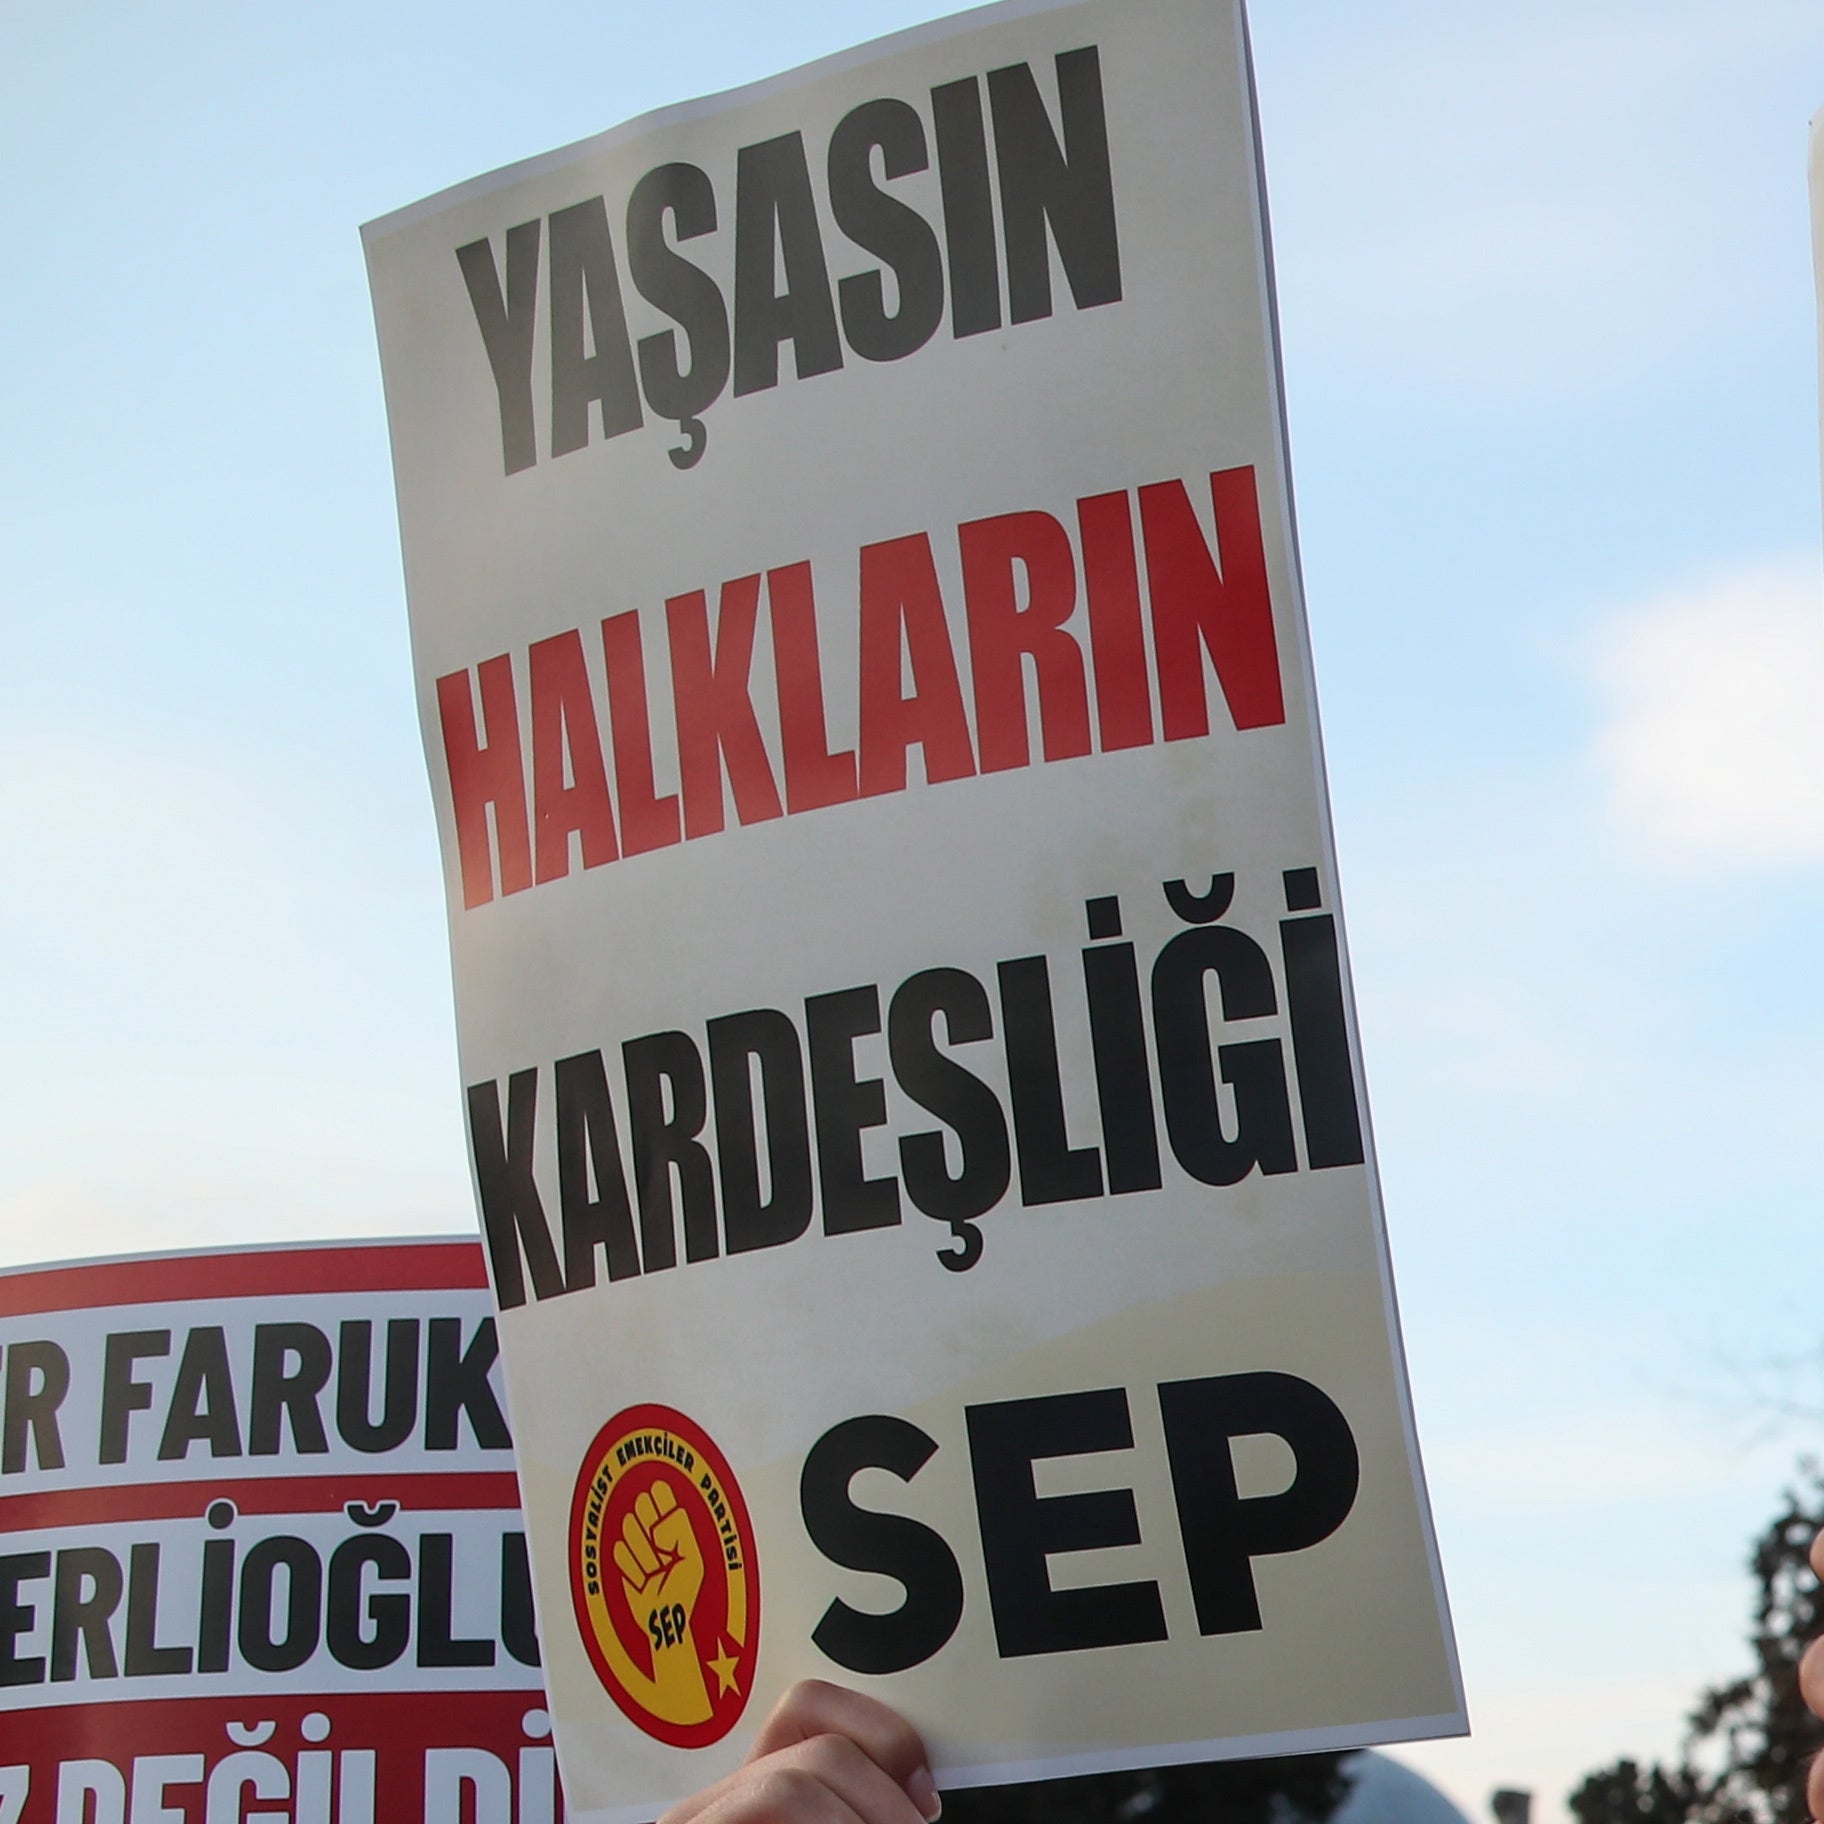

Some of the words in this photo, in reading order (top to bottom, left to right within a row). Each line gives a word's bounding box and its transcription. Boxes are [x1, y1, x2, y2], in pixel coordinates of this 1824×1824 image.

[456, 45, 1122, 477] YAŞASIN
[435, 465, 1285, 910] HALKLARIN
[467, 867, 1365, 1311] KARDEŞLİĞİ
[0, 1339, 71, 1474] R
[99, 1317, 514, 1466] FARUK
[585, 1464, 614, 1595] SOSYALİST
[616, 1431, 696, 1474] EMEKÇİLER
[700, 1473, 743, 1571] PARTİSİ
[800, 1371, 1360, 1675] SEP
[648, 1602, 687, 1652] SEP
